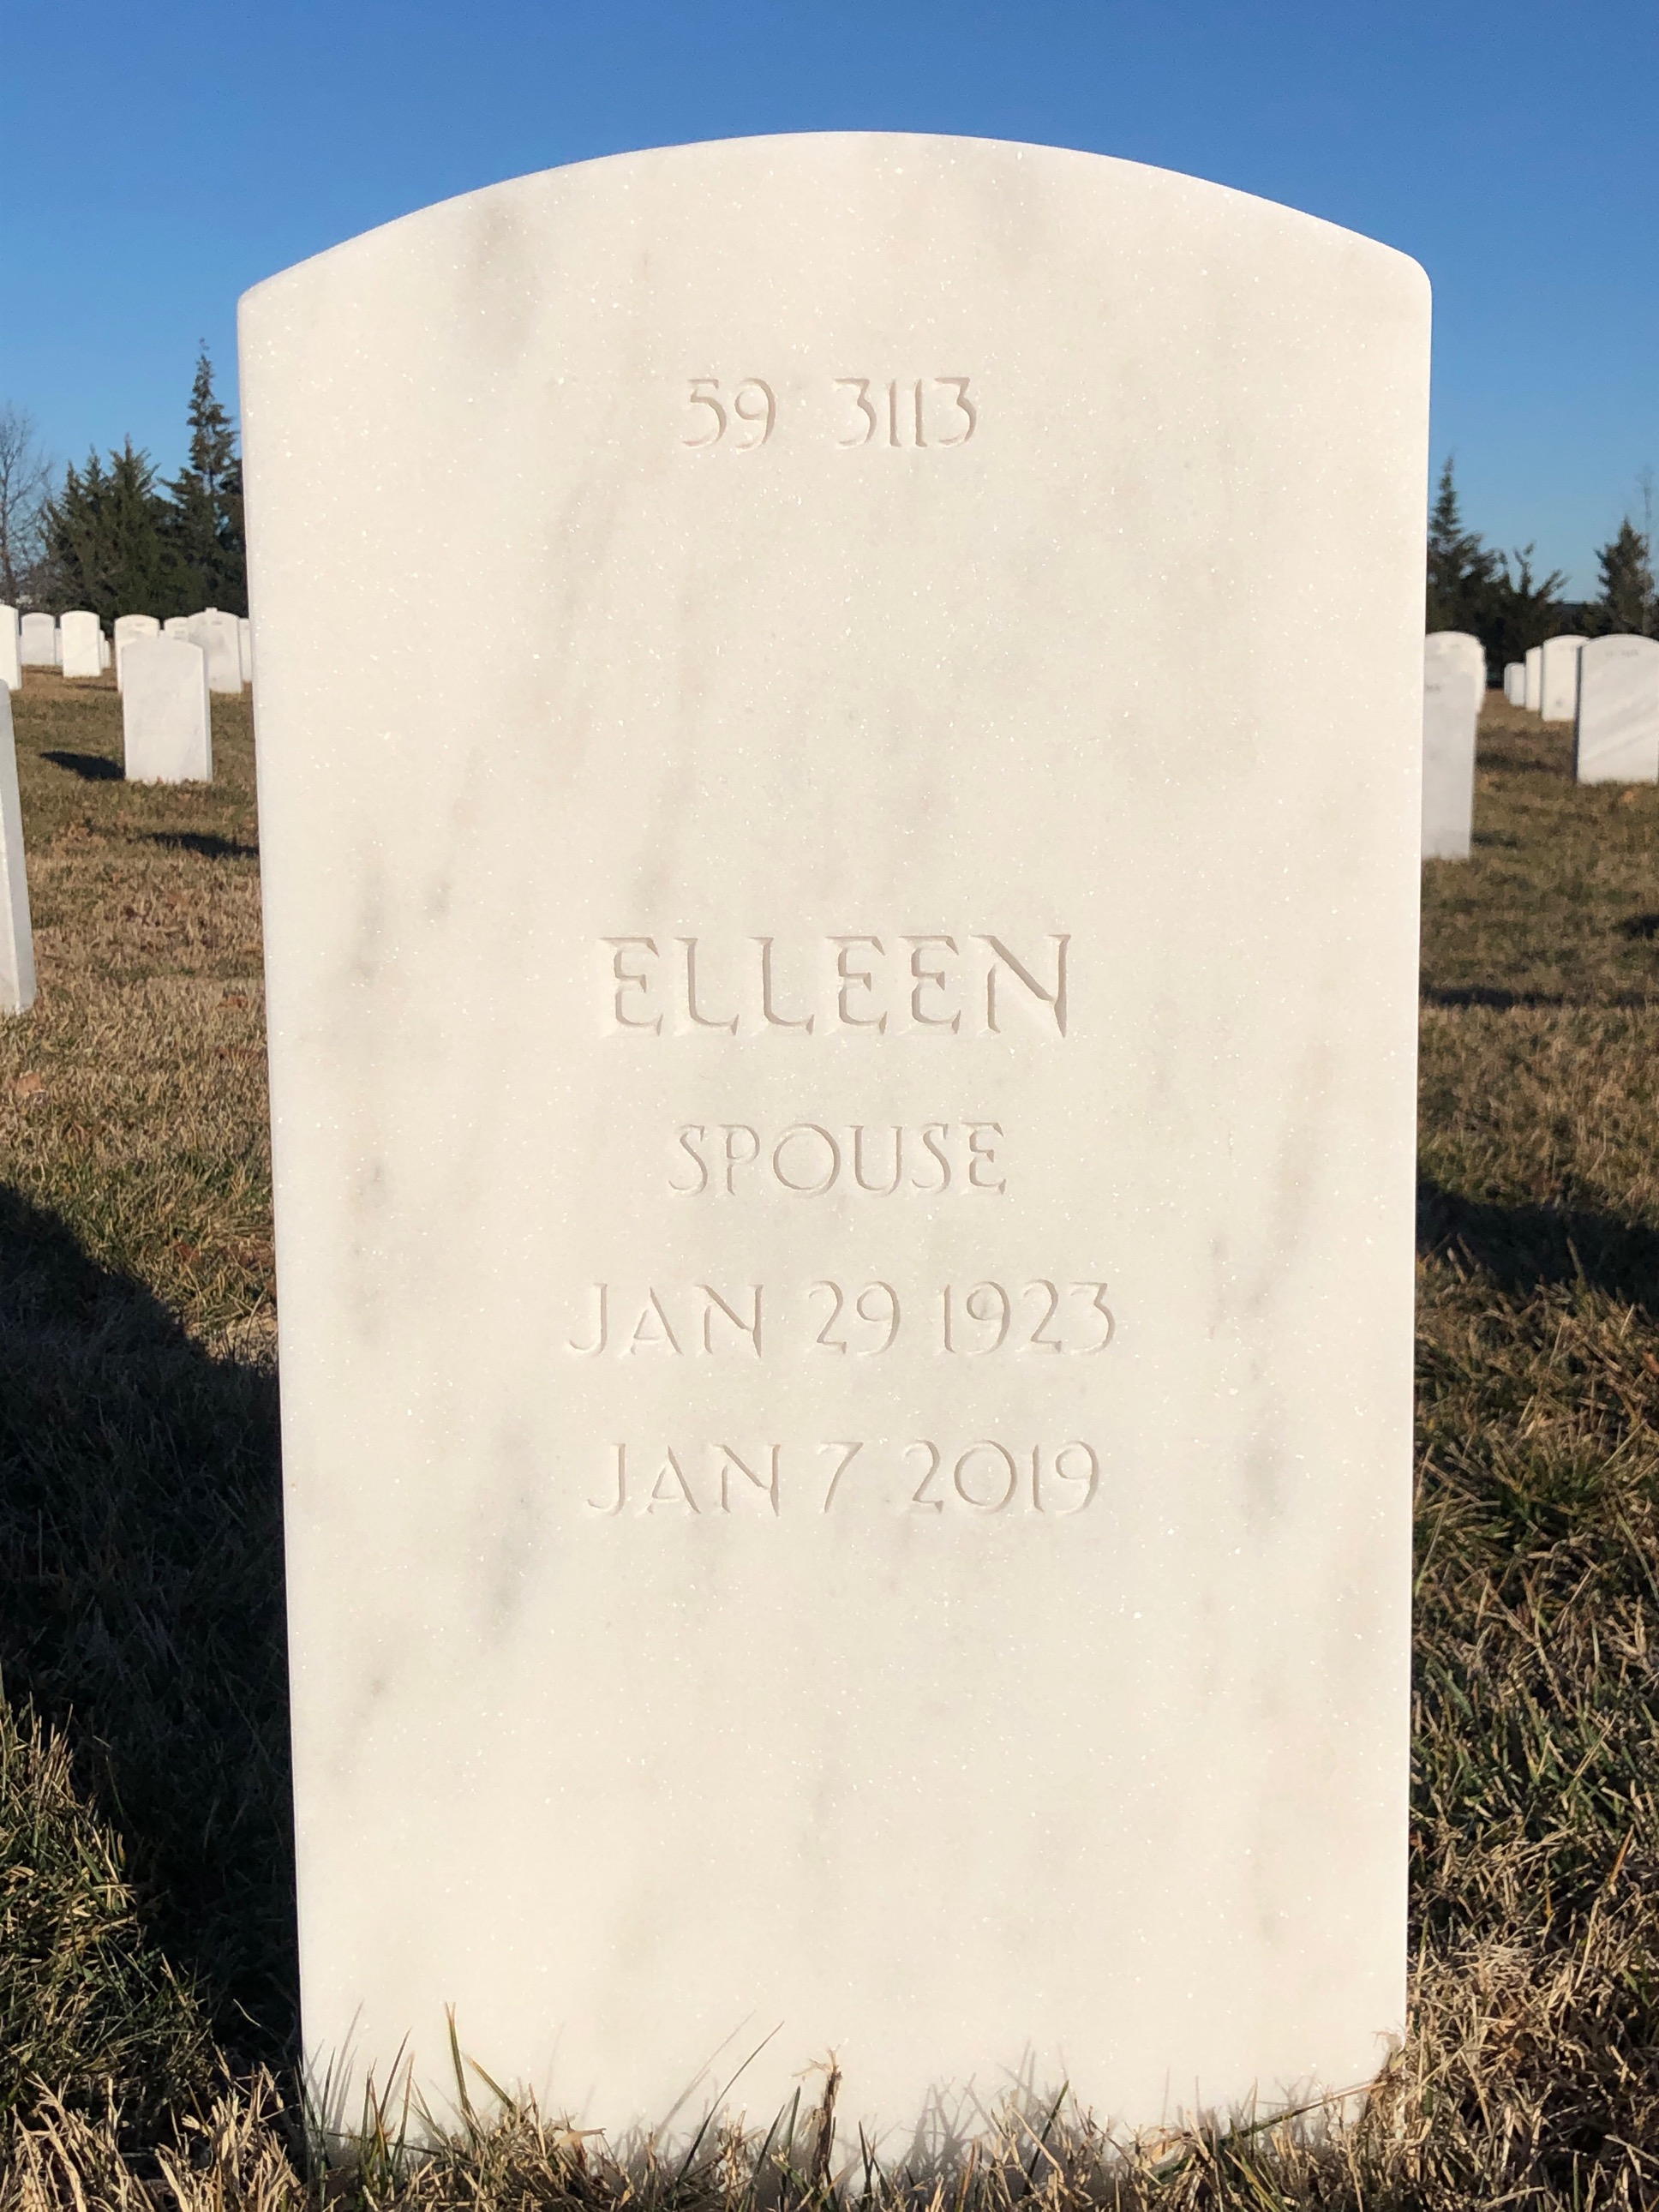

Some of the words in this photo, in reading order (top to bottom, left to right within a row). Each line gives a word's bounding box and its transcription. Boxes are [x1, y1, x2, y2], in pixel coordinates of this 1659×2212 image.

[682, 377, 776, 450] 59
[830, 376, 978, 449] 3113
[600, 934, 1071, 1038] ELLEEN
[668, 1122, 1007, 1196] SPOUSE
[569, 1283, 763, 1357] JAN
[809, 1280, 901, 1355] 29
[942, 1279, 1116, 1354] 1923
[587, 1442, 779, 1517] JAN
[818, 1442, 864, 1514] 7
[904, 1440, 1100, 1514] 2019
